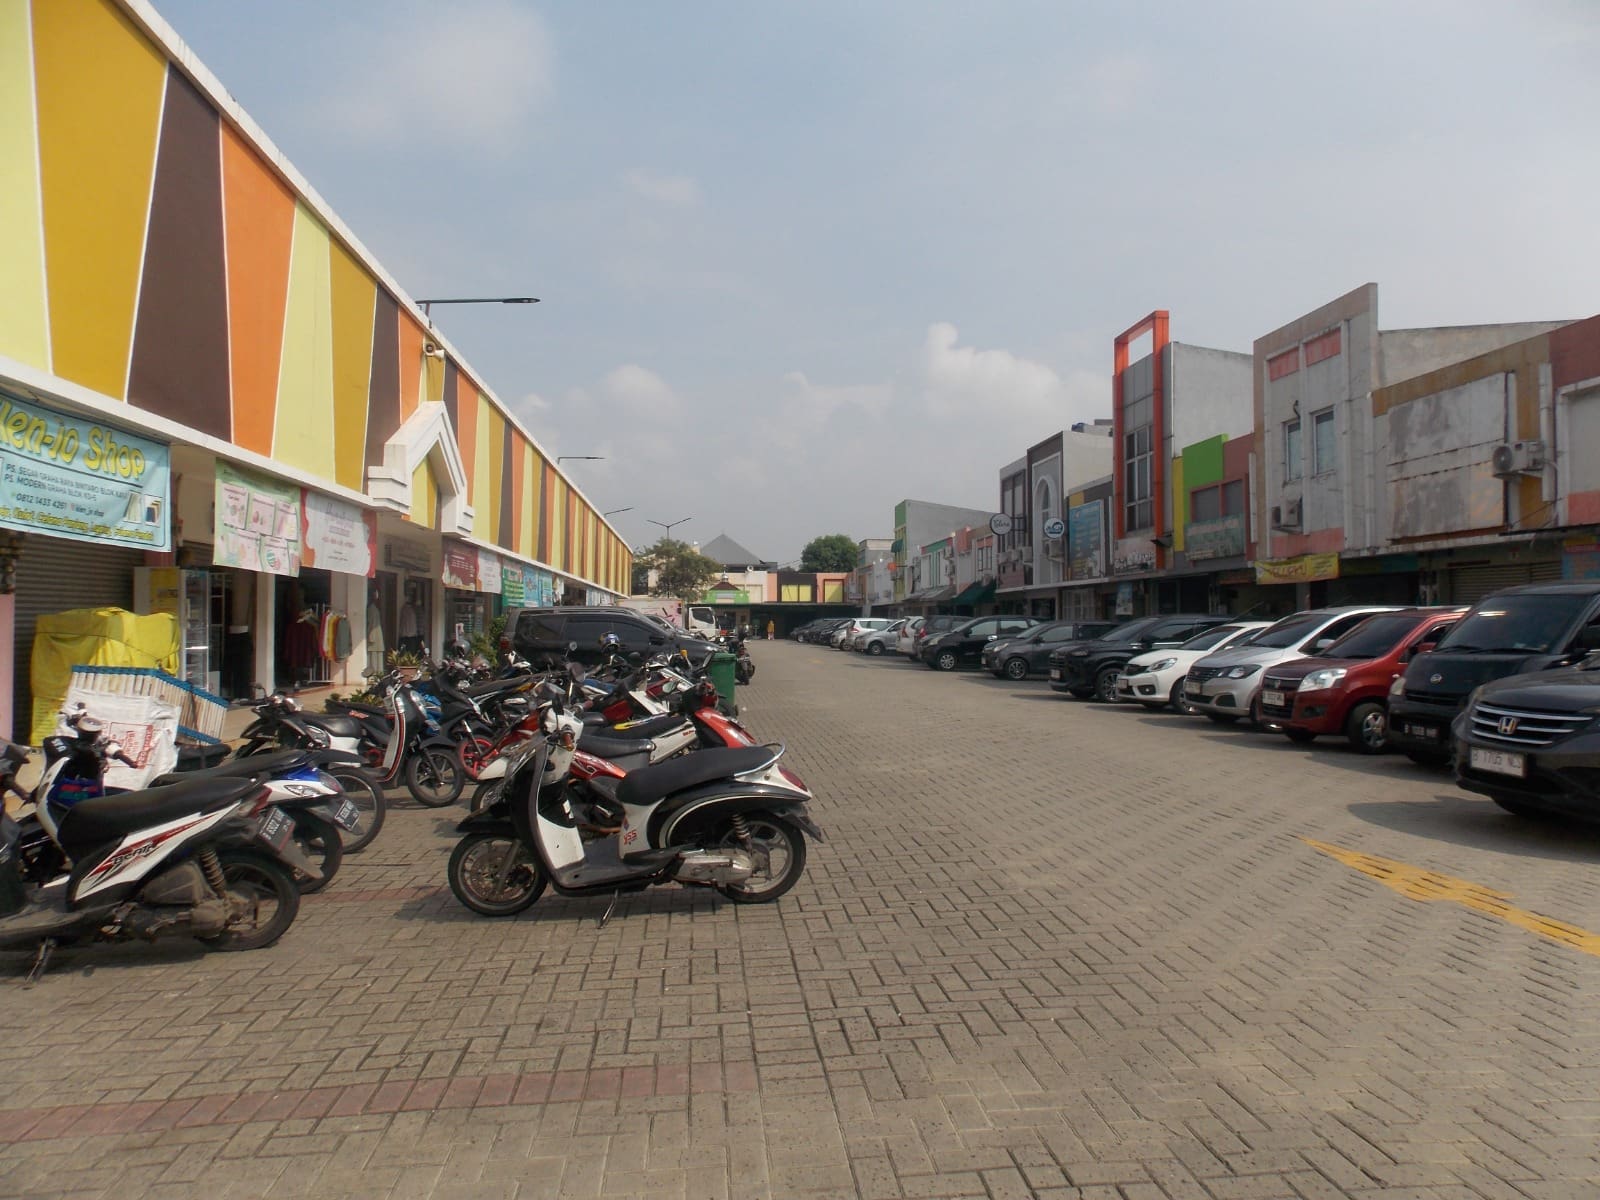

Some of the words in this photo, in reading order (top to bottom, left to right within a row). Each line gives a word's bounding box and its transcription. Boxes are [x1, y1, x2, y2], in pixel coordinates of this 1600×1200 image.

[83, 426, 146, 481] Shop
[16, 475, 47, 490] MODERN
[16, 492, 34, 504] 0812
[623, 829, 637, 845] YSS
